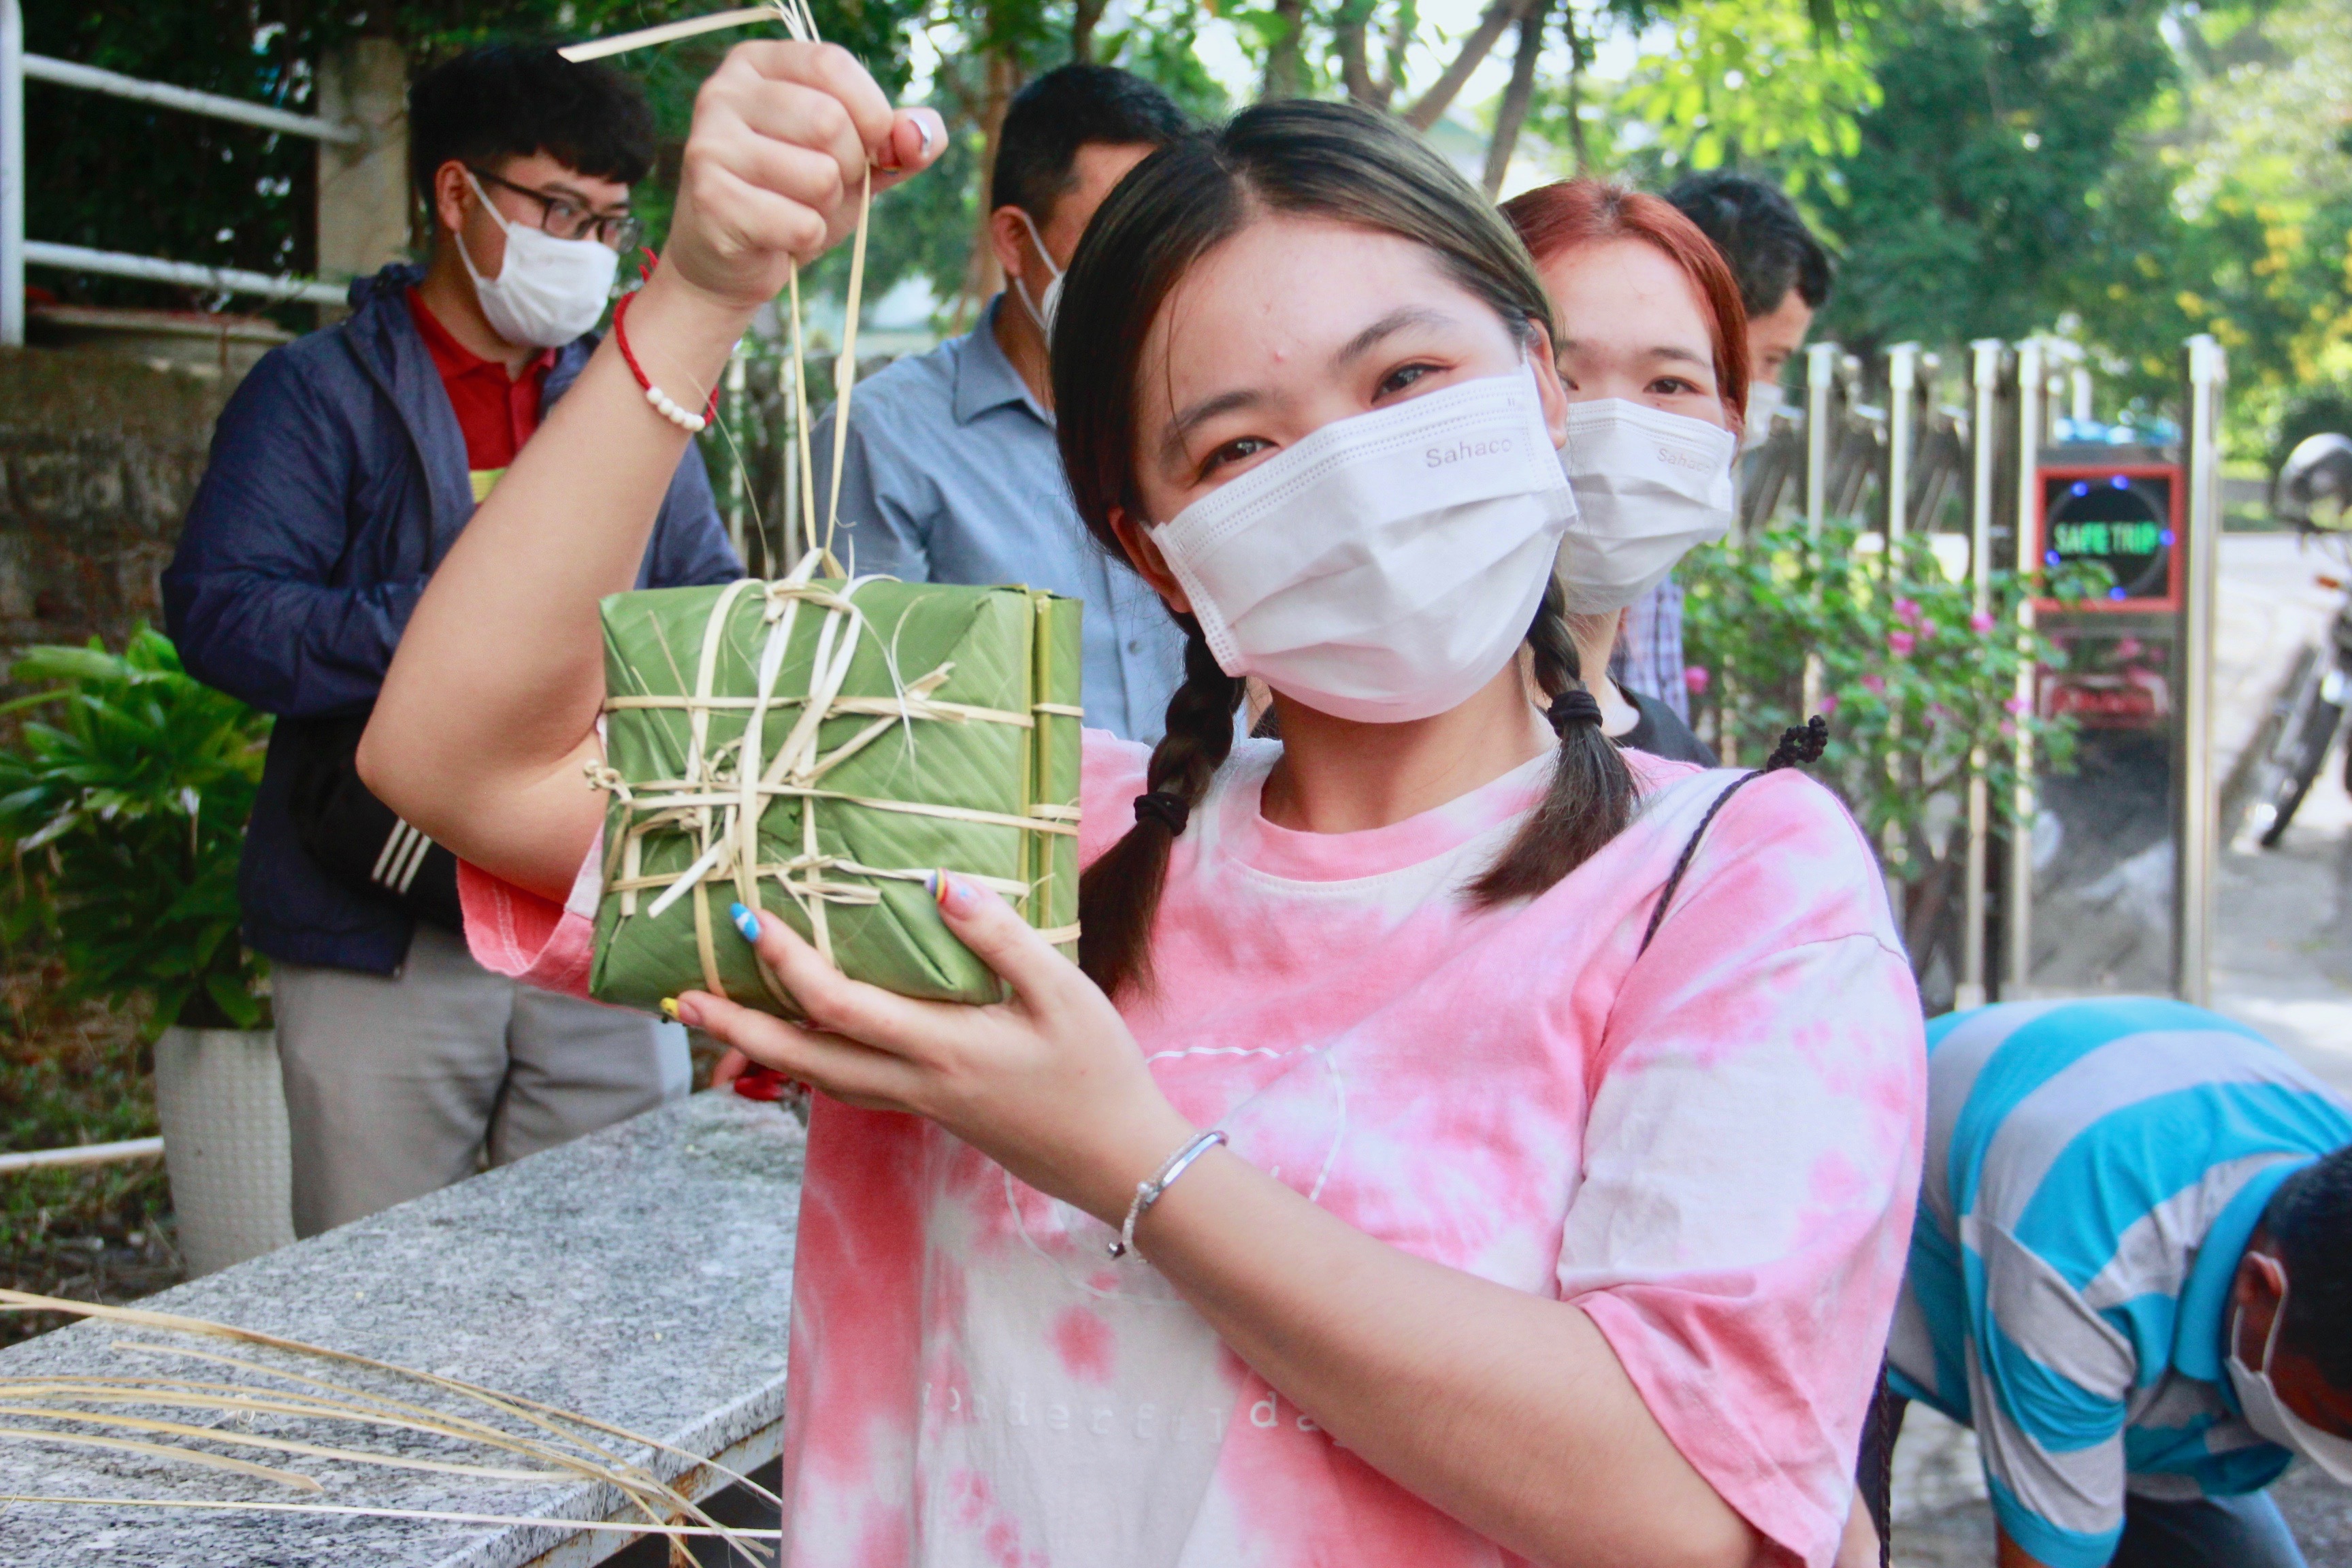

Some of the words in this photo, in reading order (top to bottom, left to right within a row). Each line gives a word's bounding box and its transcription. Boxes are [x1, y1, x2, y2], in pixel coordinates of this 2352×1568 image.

[1426, 438, 1512, 468] Sahaco
[2053, 521, 2110, 555] SAFE
[2110, 521, 2159, 555] TRIP
